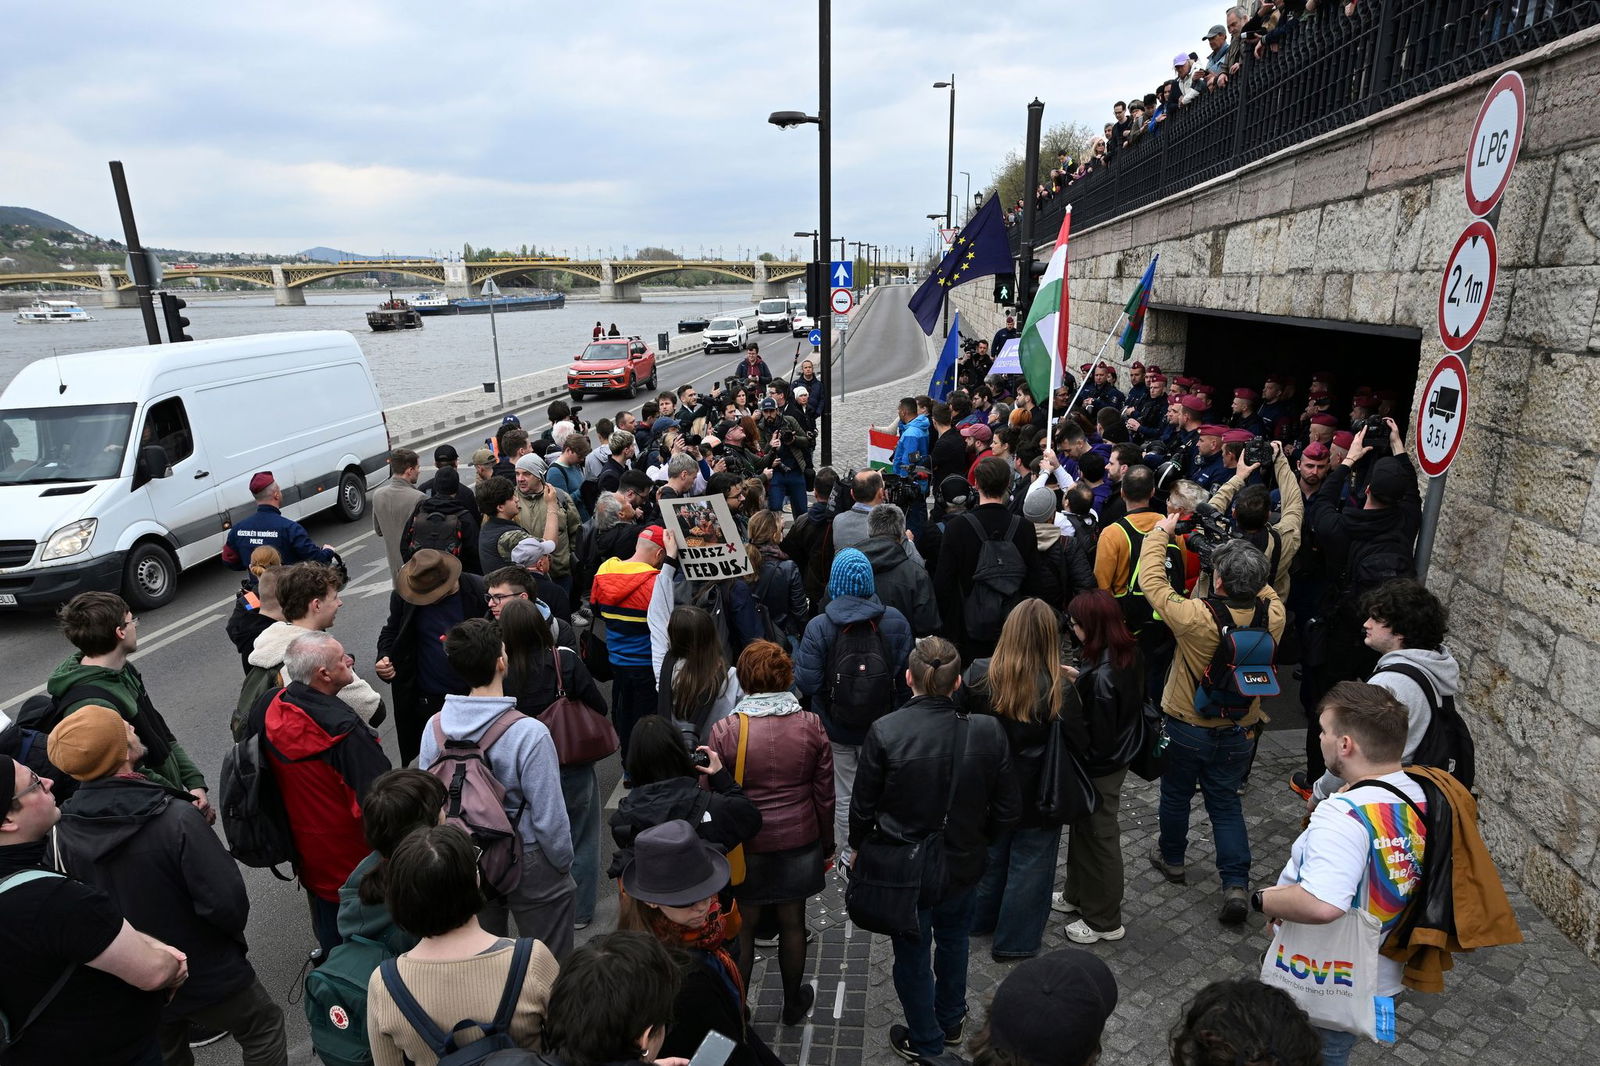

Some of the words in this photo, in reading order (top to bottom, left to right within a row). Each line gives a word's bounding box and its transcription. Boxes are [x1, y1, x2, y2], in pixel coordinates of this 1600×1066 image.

[1477, 129, 1509, 168] LPG
[678, 546, 725, 559] FIDESZ
[684, 562, 719, 578] FEED
[719, 558, 742, 577] US
[1244, 674, 1268, 683] LiveU
[1275, 943, 1354, 987] LOVE
[1305, 986, 1325, 996] thing
[1326, 988, 1334, 996] to
[1336, 988, 1353, 998] hate
